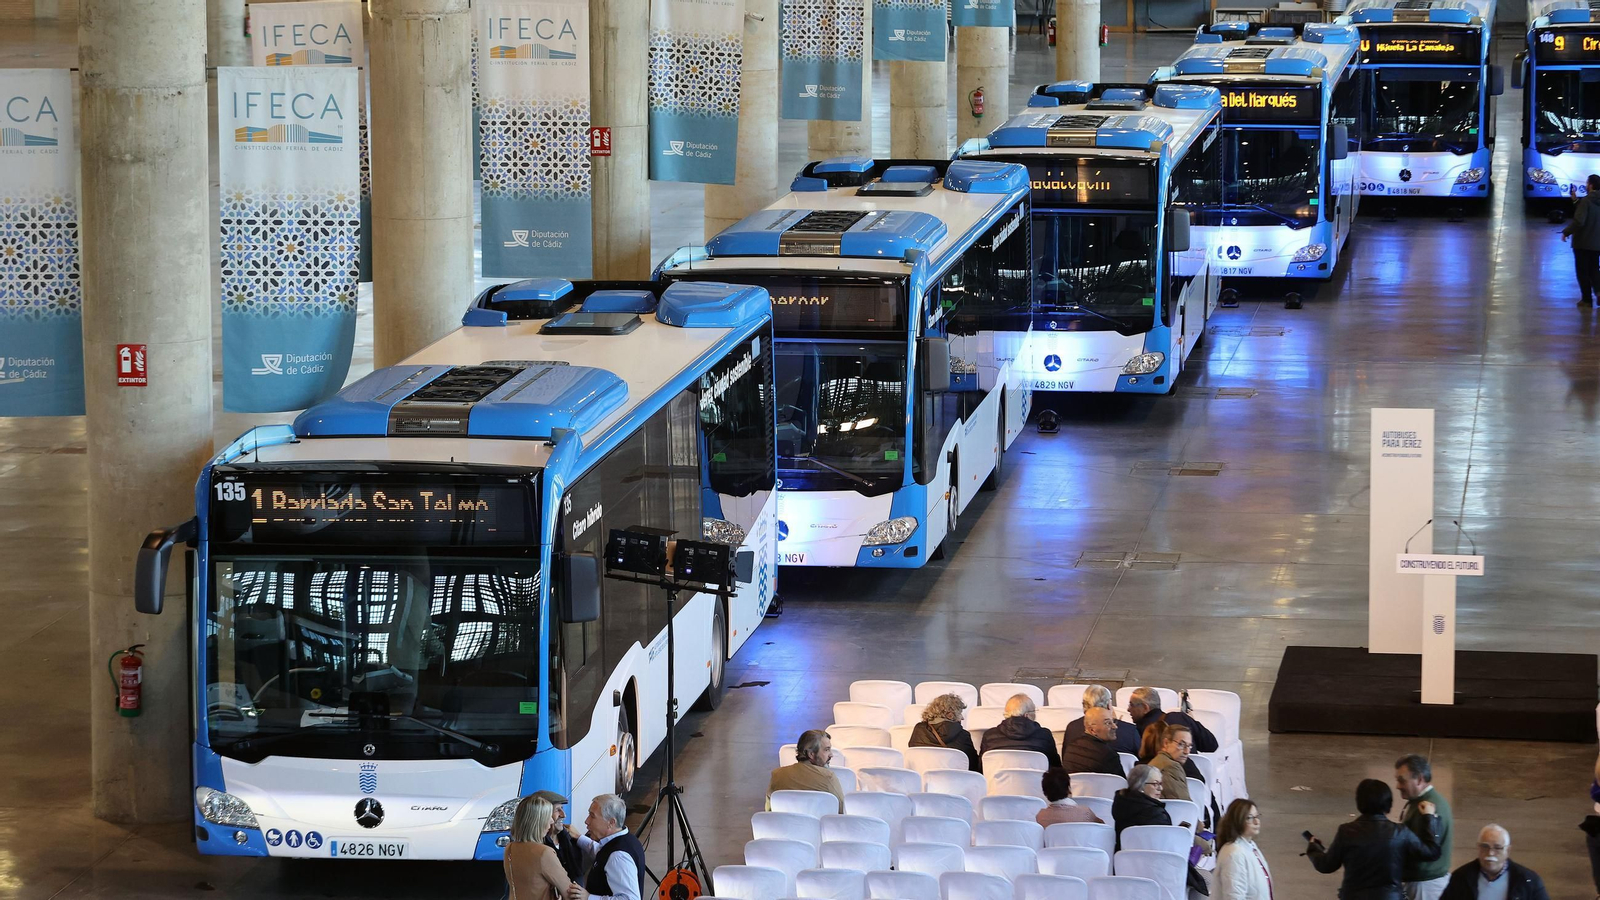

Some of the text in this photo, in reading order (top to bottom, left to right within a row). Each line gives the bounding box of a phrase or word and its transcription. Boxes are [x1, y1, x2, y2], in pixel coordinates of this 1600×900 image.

[489, 18, 577, 40] IFECA
[263, 23, 352, 47] IFECA
[1539, 33, 1555, 43] 148
[1405, 44, 1417, 52] La
[1419, 44, 1455, 52] Canaleja
[1554, 36, 1600, 51] 9 Cir
[1229, 92, 1248, 108] Del
[1249, 92, 1297, 108] Marqués
[233, 92, 343, 120] IFECA
[686, 141, 718, 151] Diputación
[531, 229, 569, 239] Diputación
[531, 239, 563, 248] de Cádiz
[8, 356, 55, 368] Diputación
[286, 352, 333, 364] Diputación
[9, 369, 47, 379] de Cádiz
[286, 364, 324, 375] de Cádiz
[1034, 380, 1074, 389] 4829 NGV
[1382, 431, 1417, 439] AUTOBUSES
[1382, 439, 1422, 448] PARA JEREZ
[214, 481, 247, 502] 135
[251, 488, 263, 510] 1
[784, 553, 805, 563] NGV
[1400, 559, 1447, 569] CONSTRUYENDO
[1448, 561, 1455, 569] EL
[340, 842, 405, 857] 4826 NGV
